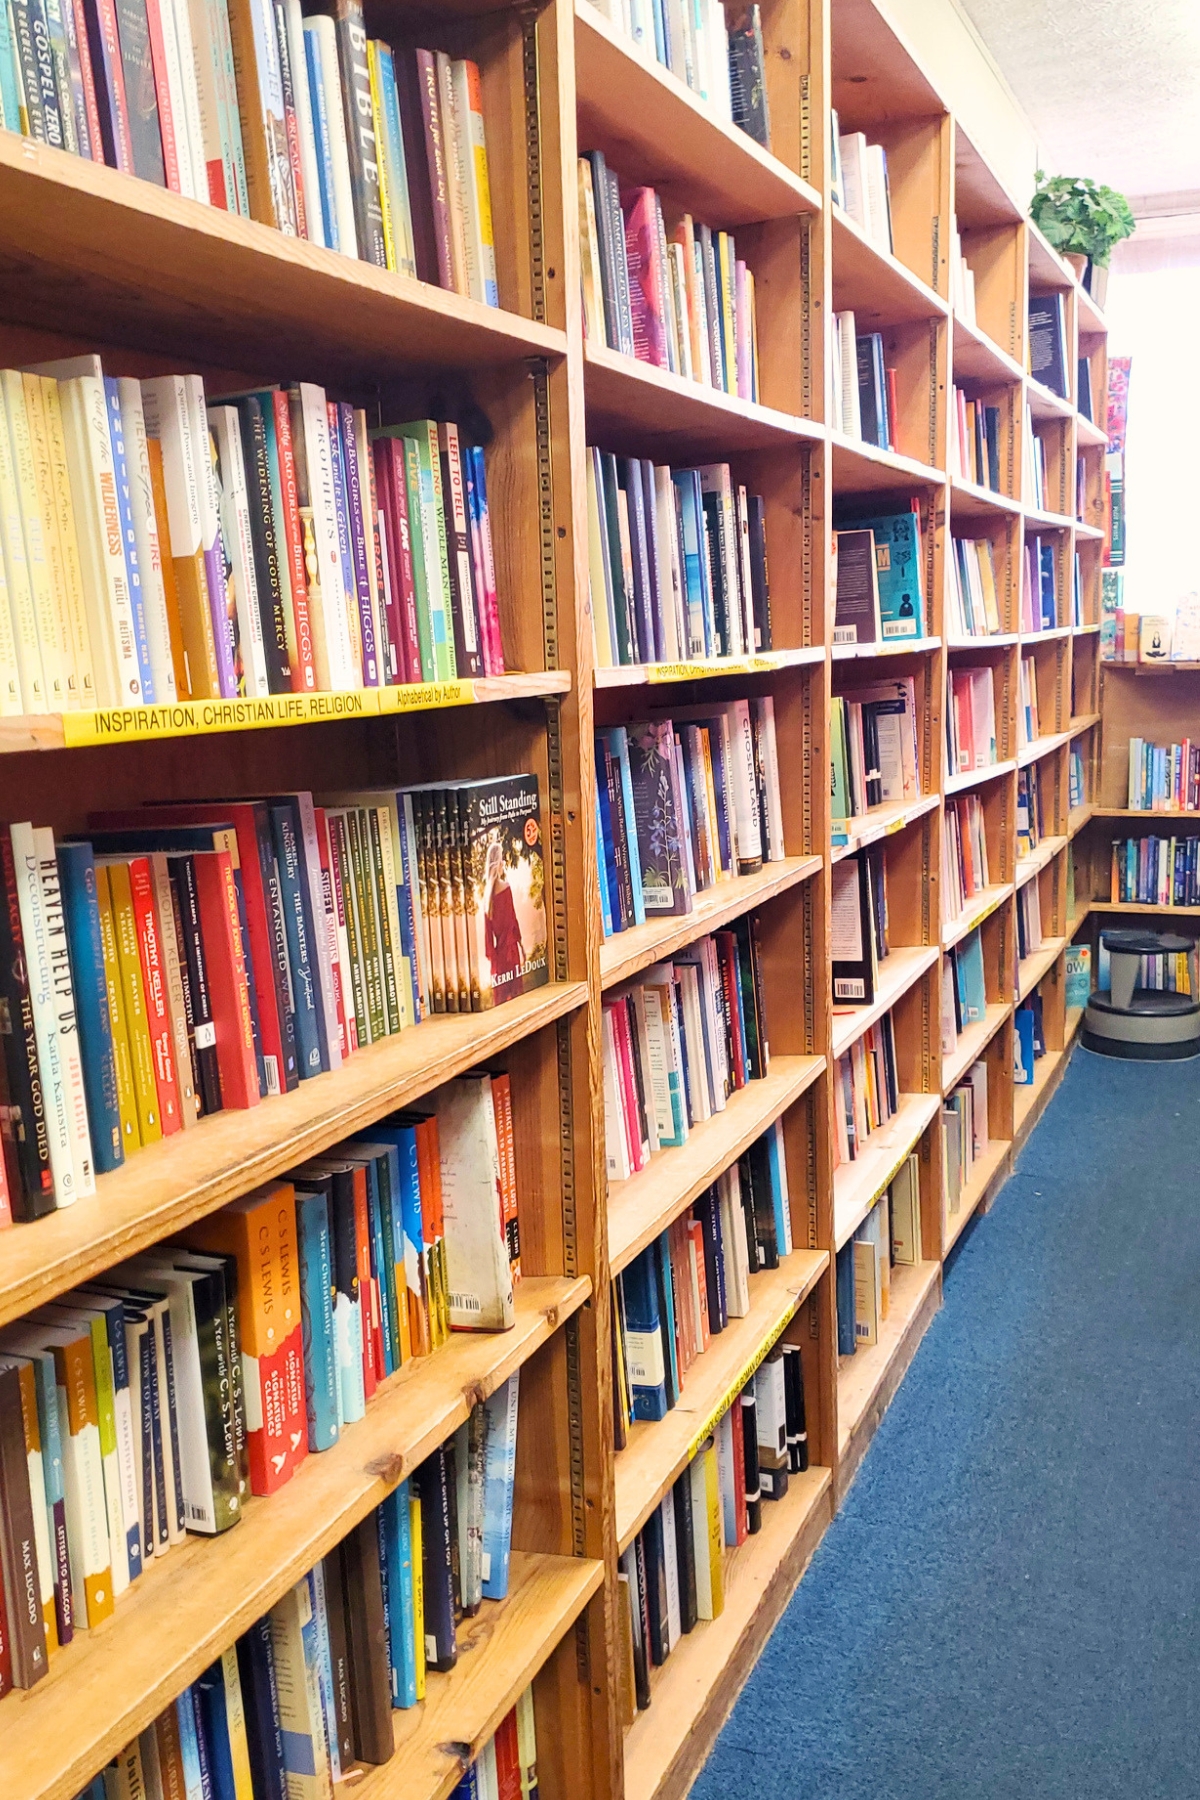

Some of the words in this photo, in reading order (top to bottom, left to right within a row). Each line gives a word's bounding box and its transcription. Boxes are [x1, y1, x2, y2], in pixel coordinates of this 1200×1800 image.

[32, 19, 55, 98] GOSPEL
[44, 104, 62, 143] ZERO
[346, 21, 384, 186] BIBLE
[612, 210, 627, 301] IMMORTALITY
[620, 305, 630, 330] KEY
[175, 387, 189, 431] Spiritual
[252, 414, 263, 446] THE
[181, 437, 192, 460] Power
[448, 435, 459, 464] LEFT
[256, 448, 272, 523] WIDENING
[407, 451, 418, 491] LIVE
[452, 470, 462, 490] TO
[110, 396, 141, 587] UNDIVIDED
[187, 486, 199, 525] Integrity
[454, 493, 464, 517] TELL
[99, 471, 121, 555] WILDERNESS
[242, 508, 253, 554] CHRISTIANS
[266, 530, 275, 548] OF
[247, 556, 256, 588] AGAINST
[720, 546, 728, 566] Flesh
[267, 554, 280, 598] GOD'S
[251, 591, 262, 642] CHRISTIANITY
[273, 605, 286, 650] MERCY
[297, 599, 313, 659] HIGGS
[360, 597, 376, 655] HIGGS
[397, 686, 433, 706] Alphabetical
[435, 688, 441, 703] by
[443, 686, 461, 700] Author
[95, 708, 199, 734] INSPIRATION,
[203, 703, 275, 726] CHRISTIAN
[278, 700, 307, 719] LIFE,
[310, 695, 362, 716] RELIGION
[742, 718, 755, 782] CHOSEN
[479, 795, 498, 817] Still
[499, 790, 537, 812] Standing
[615, 796, 623, 817] Who
[719, 784, 729, 823] Heaven
[748, 788, 759, 827] LAND
[617, 818, 626, 842] Really
[281, 821, 295, 880] KINGSBURY
[620, 844, 629, 869] Wrote
[39, 858, 65, 936] HEAVEN
[320, 871, 332, 912] STREET
[625, 884, 633, 905] Bible
[20, 854, 54, 1002] Deconstructing
[103, 910, 115, 963] TIMOTHY
[119, 911, 130, 955] KELLER
[125, 905, 136, 956] TIMOTHY
[144, 910, 159, 966] TIMOTHY
[157, 872, 175, 938] TIMOTHY
[166, 946, 182, 1002] KELLER
[325, 916, 336, 961] SMARTS
[50, 946, 72, 996] HELP
[194, 945, 204, 979] IMITATION
[268, 877, 286, 970] ENTANGLED
[279, 975, 295, 1042] WORLDS
[352, 962, 361, 983] ANNE
[364, 959, 374, 981] ANNE
[371, 956, 381, 978] ANNE
[385, 952, 393, 974] ANNE
[106, 979, 118, 1023] PRAYER
[129, 972, 141, 1014] PRAYER
[151, 970, 165, 1017] KELLER
[181, 973, 194, 1024] TIMOTHY
[199, 982, 206, 992] OF
[354, 985, 363, 1017] LAMOTT
[367, 983, 377, 1015] LAMOTT
[373, 980, 383, 1011] LAMOTT
[386, 976, 397, 1008] LAMOTT
[20, 994, 33, 1028] THE
[58, 1011, 77, 1034] US
[200, 994, 209, 1018] CHRIST
[724, 1001, 732, 1026] HOUSE
[45, 1030, 63, 1074] Karla
[173, 1015, 189, 1056] forgive
[25, 1032, 39, 1076] YEAR
[31, 1078, 44, 1116] GOD
[51, 1079, 72, 1147] Kamstra
[36, 1120, 50, 1160] DIED
[257, 1225, 268, 1240] C
[276, 1209, 286, 1223] C
[260, 1244, 269, 1255] S
[278, 1228, 288, 1238] S
[317, 1229, 327, 1259] Mere
[278, 1242, 293, 1296] LEWIS
[260, 1259, 274, 1315] LEWIS
[319, 1263, 333, 1335] Christianity
[212, 1317, 221, 1326] A
[226, 1306, 234, 1314] A
[381, 1307, 389, 1328] FOUR
[213, 1326, 223, 1351] Year
[227, 1315, 237, 1339] Year
[383, 1328, 391, 1352] LOVES
[141, 1350, 149, 1378] HOW
[215, 1353, 227, 1377] with
[228, 1341, 240, 1364] with
[217, 1377, 230, 1398] C.
[230, 1364, 241, 1385] C.
[286, 1349, 300, 1417] SIGNATURE
[142, 1385, 150, 1401] TO
[231, 1386, 243, 1404] S.
[262, 1379, 276, 1437] CLASSICS
[267, 1369, 285, 1438] SIGNATURE
[508, 1390, 517, 1423] UNTIL
[697, 1406, 727, 1443] CATHOLICISM
[730, 1386, 740, 1400] THE
[739, 1367, 756, 1387] ROMAN
[755, 1341, 776, 1368] CATHOLIC
[143, 1404, 151, 1435] PRAY
[220, 1400, 232, 1418] S.
[221, 1418, 237, 1467] Lewis
[232, 1405, 245, 1451] Lewis
[507, 1428, 515, 1444] MY
[438, 1452, 446, 1484] NEVER
[505, 1446, 514, 1489] MEMORY
[440, 1485, 448, 1513] GIVES
[504, 1492, 513, 1523] FAILS
[442, 1514, 449, 1527] UP
[443, 1529, 450, 1545] ON
[503, 1527, 511, 1542] ME
[21, 1539, 32, 1571] MAX
[56, 1524, 67, 1562] LETTERS
[59, 1563, 68, 1578] TO
[23, 1570, 39, 1625] LUCADO
[60, 1578, 72, 1627] MALCOLM
[336, 1657, 345, 1680] MAX
[338, 1681, 348, 1723] LUCADO
